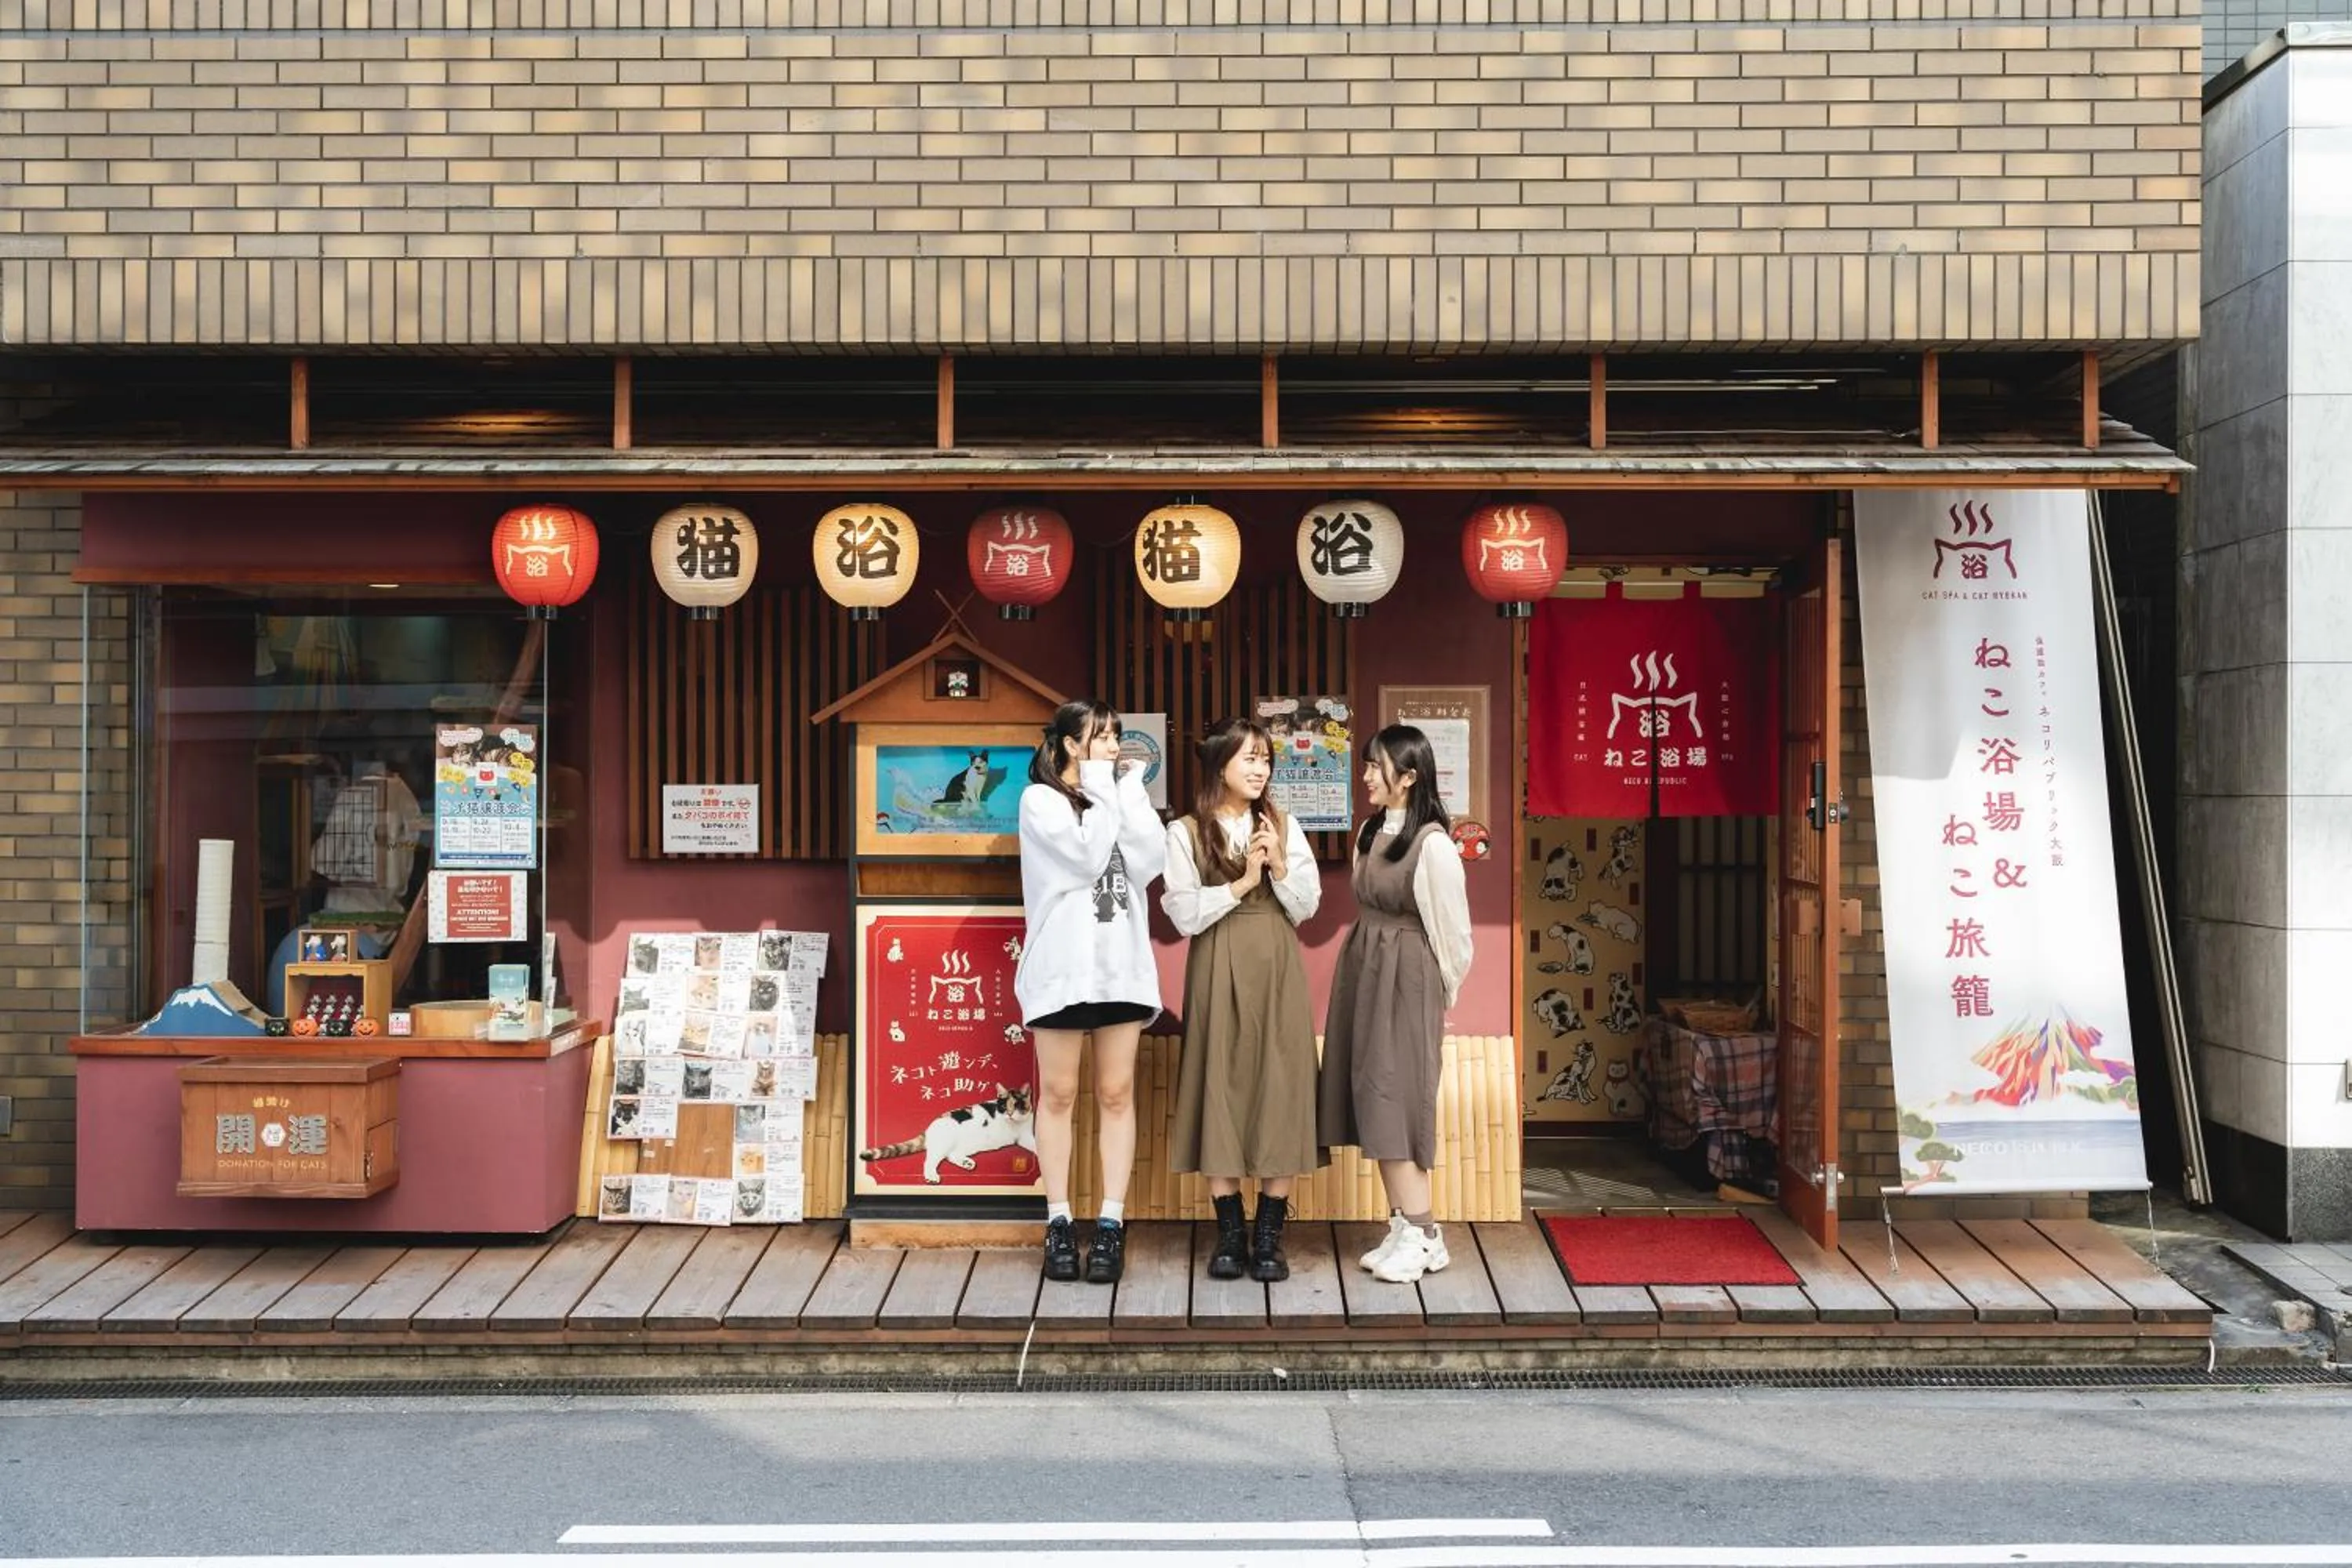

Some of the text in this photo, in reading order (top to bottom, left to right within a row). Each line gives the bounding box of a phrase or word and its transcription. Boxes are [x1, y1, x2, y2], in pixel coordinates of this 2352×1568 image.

[677, 517, 741, 579] 猫
[837, 515, 901, 579] 浴
[1142, 520, 1202, 583] 猫
[1310, 512, 1374, 576] 浴
[526, 555, 547, 577] 浴
[1007, 554, 1029, 576] 浴
[1501, 550, 1524, 572] 浴
[1962, 554, 1988, 579] 浴
[1639, 710, 1670, 738] 浴
[1604, 746, 1707, 768] ねこ浴場
[1942, 814, 1994, 1018] ねこ旅籠
[927, 1007, 985, 1021] ねこ浴場
